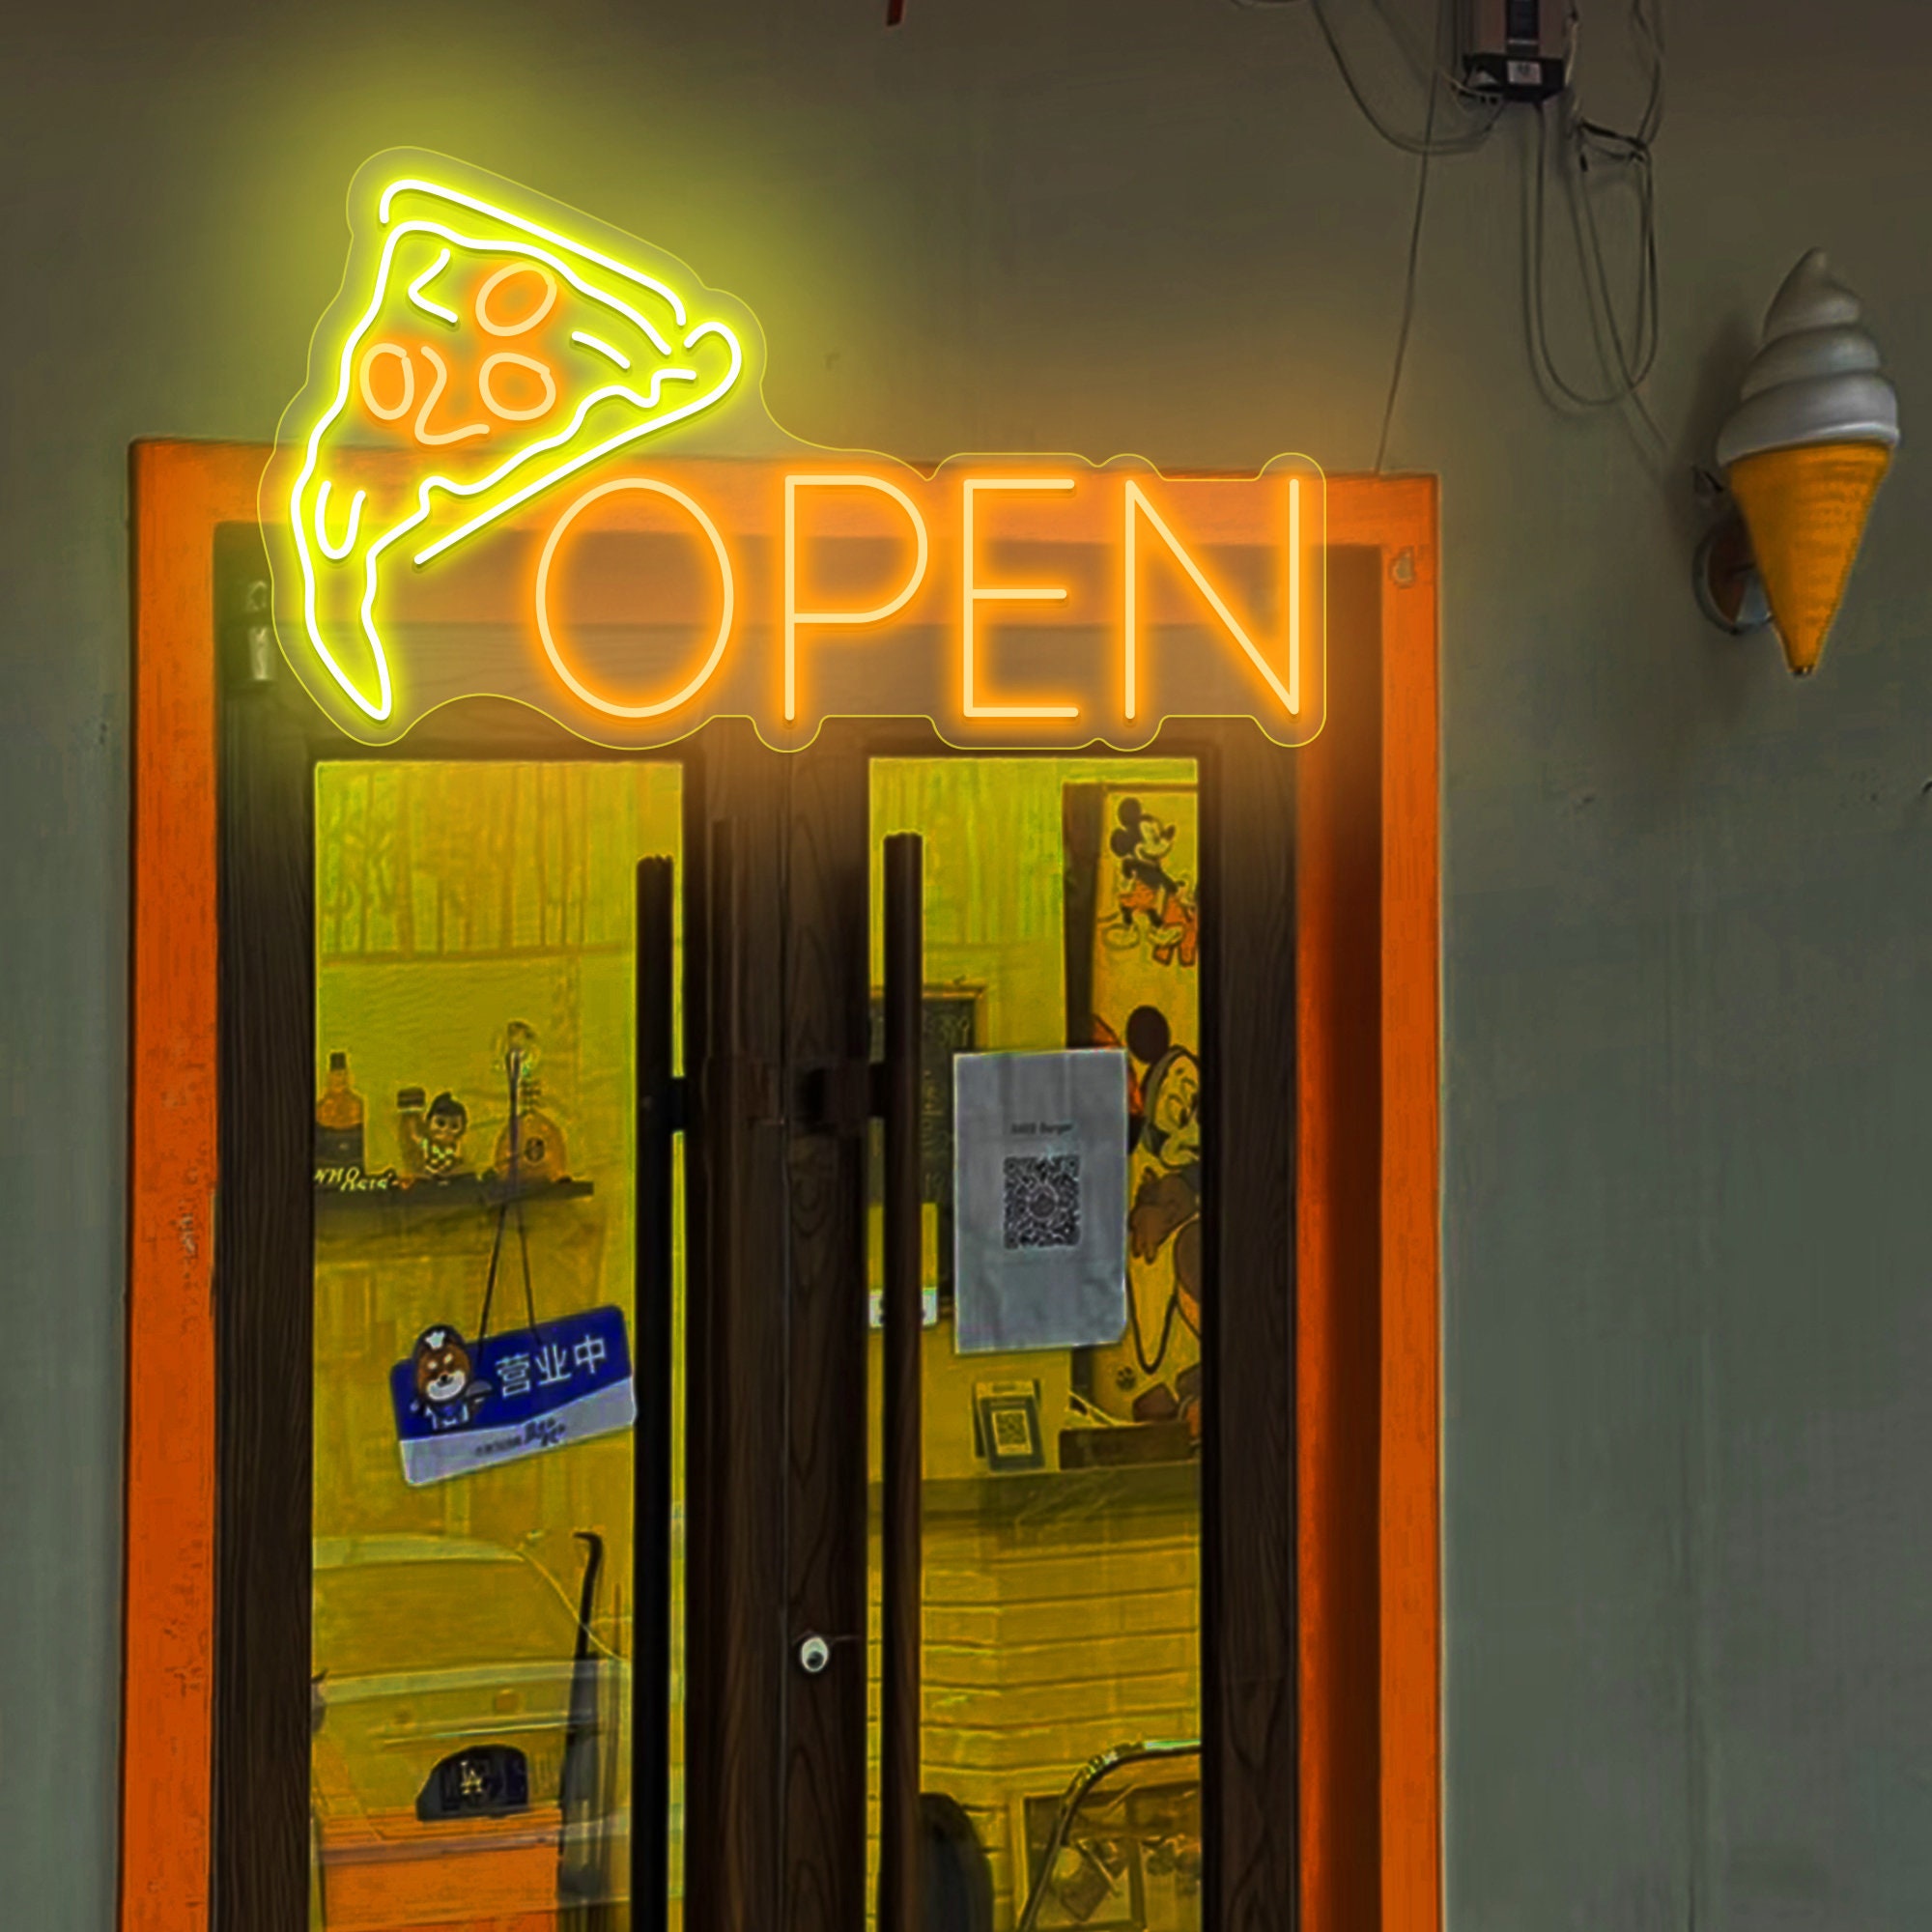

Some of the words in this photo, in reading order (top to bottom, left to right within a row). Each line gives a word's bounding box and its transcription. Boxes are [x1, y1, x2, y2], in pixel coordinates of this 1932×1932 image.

[535, 474, 1299, 721] OPEN
[495, 1335, 606, 1398] 营业中
